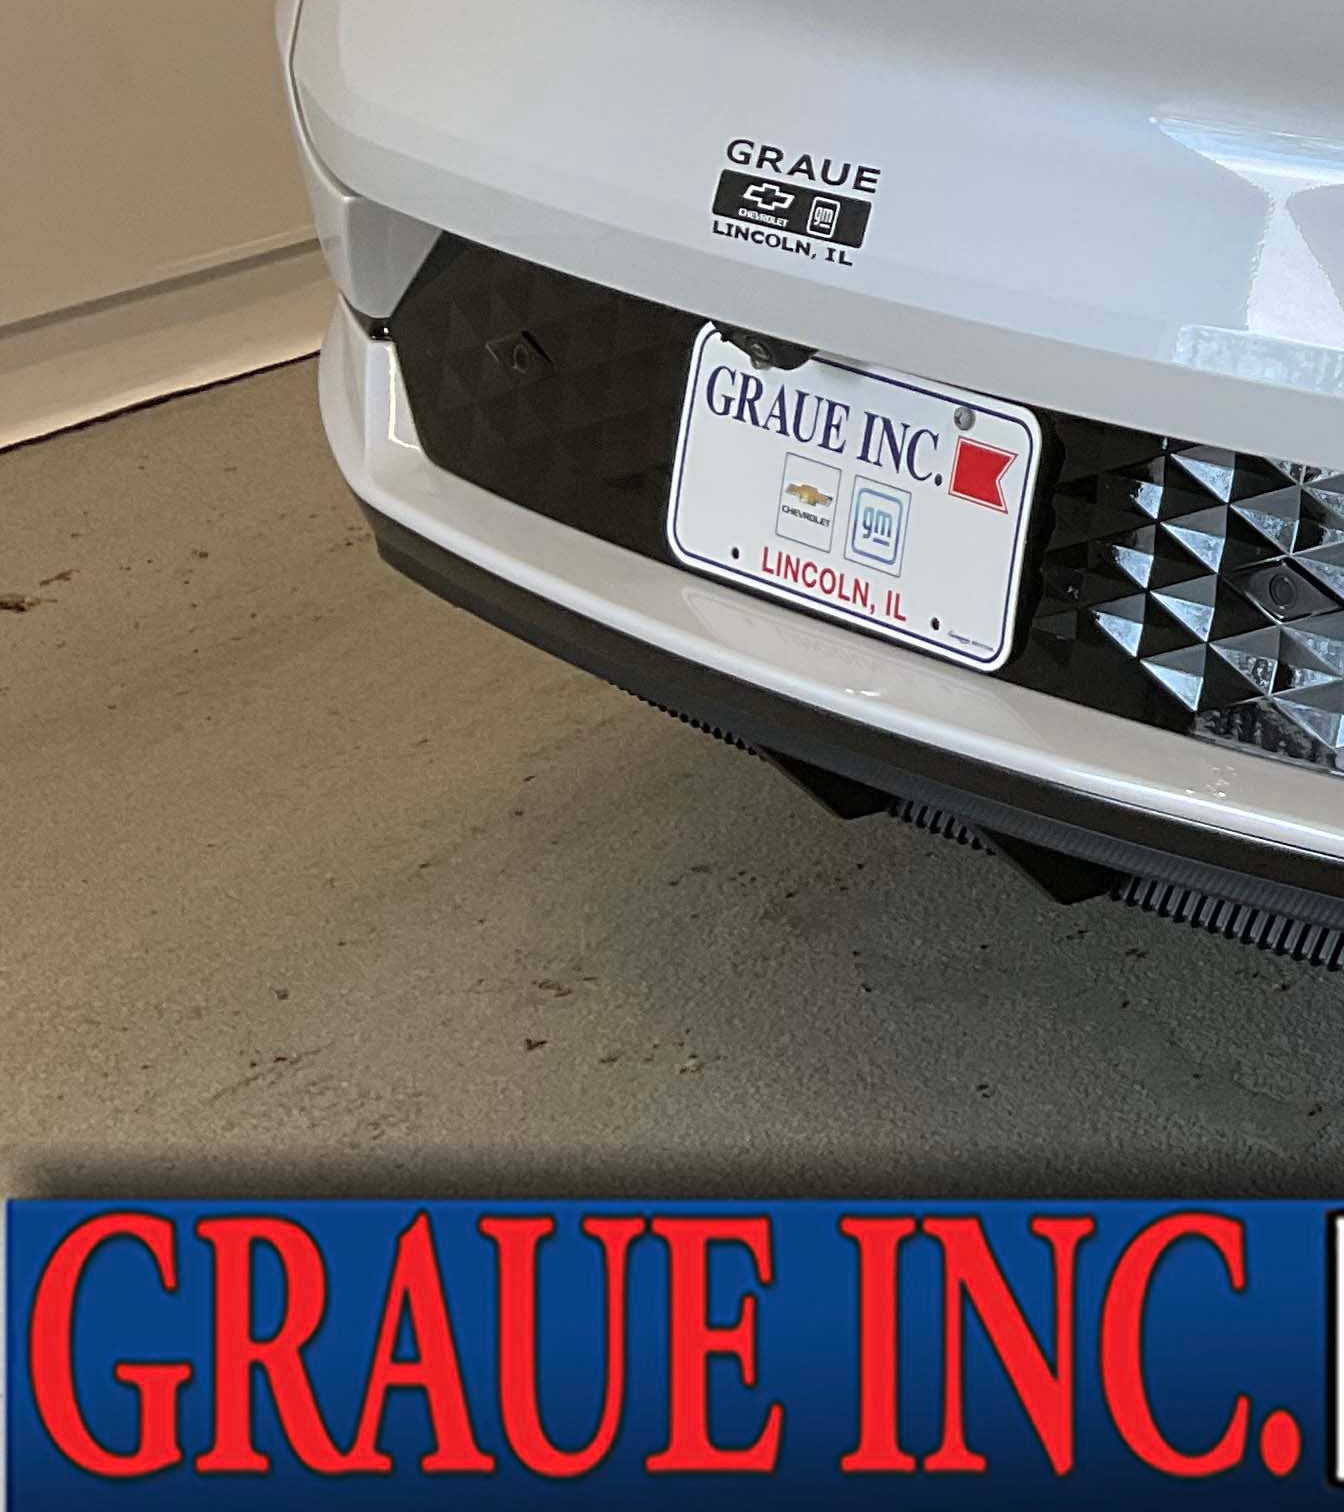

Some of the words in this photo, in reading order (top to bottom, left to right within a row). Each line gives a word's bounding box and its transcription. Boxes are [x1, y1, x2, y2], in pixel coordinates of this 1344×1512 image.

[726, 138, 881, 194] GRAUE
[712, 220, 817, 260] LINCOLN,
[825, 247, 853, 267] IL
[706, 365, 851, 454] GRAUE
[856, 410, 943, 487] INC.
[781, 503, 831, 529] CHEVROLET
[862, 505, 893, 547] gm
[761, 546, 876, 615] LINCOLN,
[885, 590, 907, 622] IL
